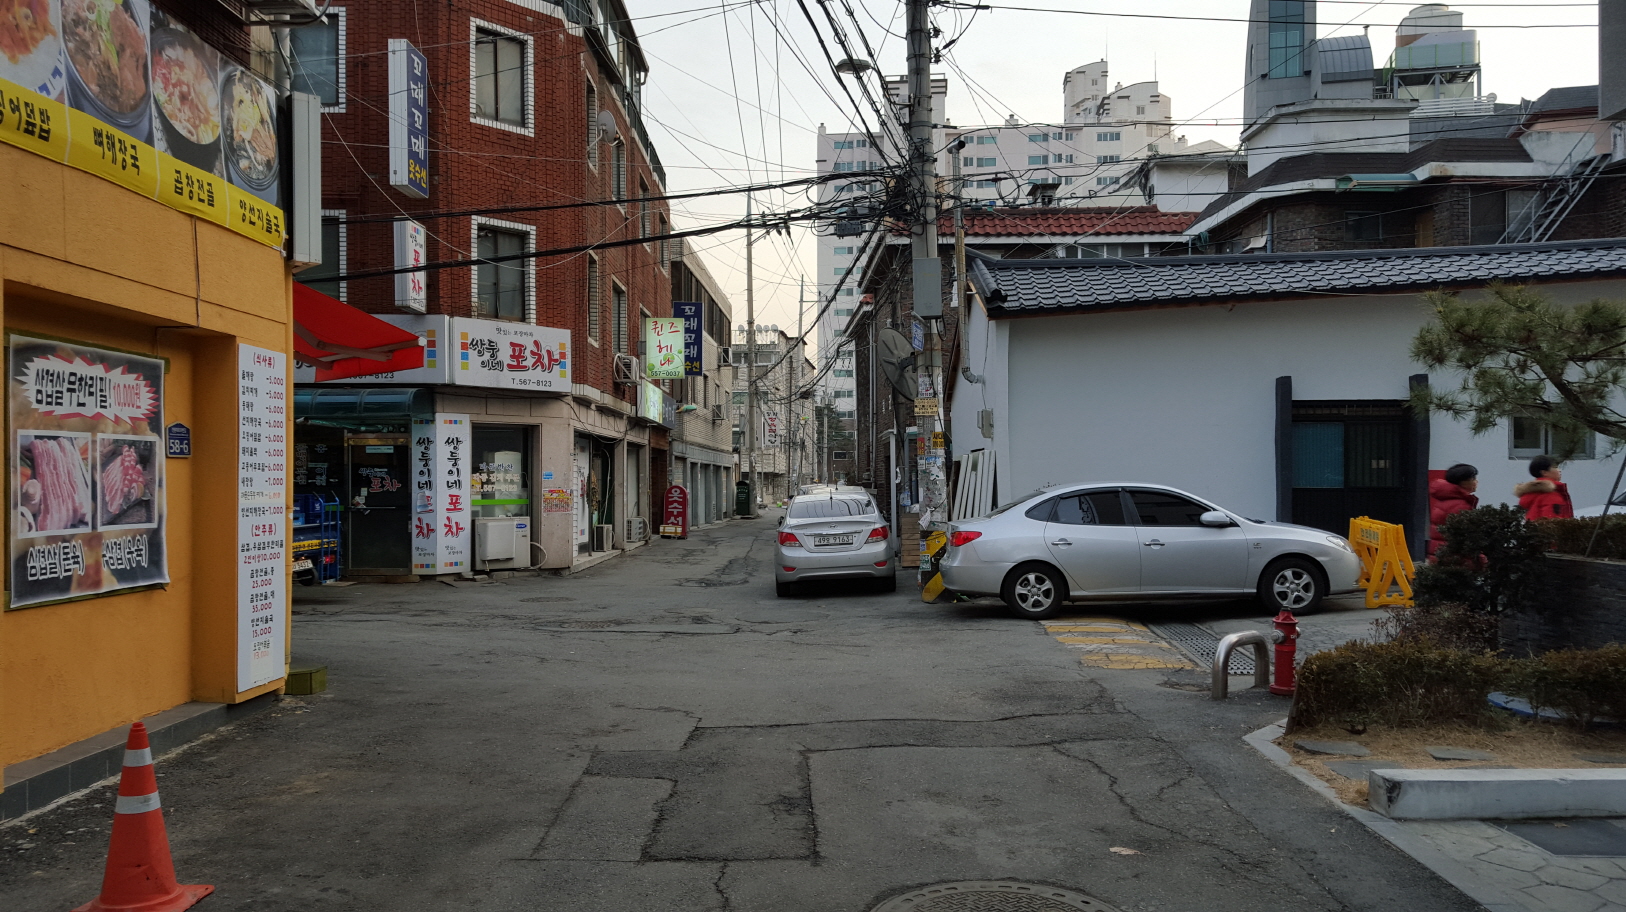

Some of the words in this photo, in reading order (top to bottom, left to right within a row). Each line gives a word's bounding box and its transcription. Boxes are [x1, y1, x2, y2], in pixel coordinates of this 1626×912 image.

[93, 126, 140, 176] 뼈해장국
[174, 170, 215, 208] 곱창전골
[409, 159, 427, 188] 옷수선
[239, 199, 281, 238] 양선지술국
[651, 320, 680, 336] 퀸즈
[253, 352, 275, 369] (식사류)
[506, 340, 561, 373] 포차
[36, 368, 65, 406] 삼겹살
[66, 372, 111, 409] 무한리필!
[113, 382, 142, 411] 10,000원
[511, 378, 552, 388] T.567-8123
[170, 440, 188, 452] 58-6
[416, 436, 434, 492] 쌍둥이네
[444, 436, 463, 492] 쌍둥이네
[369, 476, 402, 492] 포차
[444, 494, 465, 538] 포차
[667, 488, 683, 525] 옷수선
[251, 522, 276, 537] (안주류)
[27, 540, 85, 581] 삼겹살(돈육)
